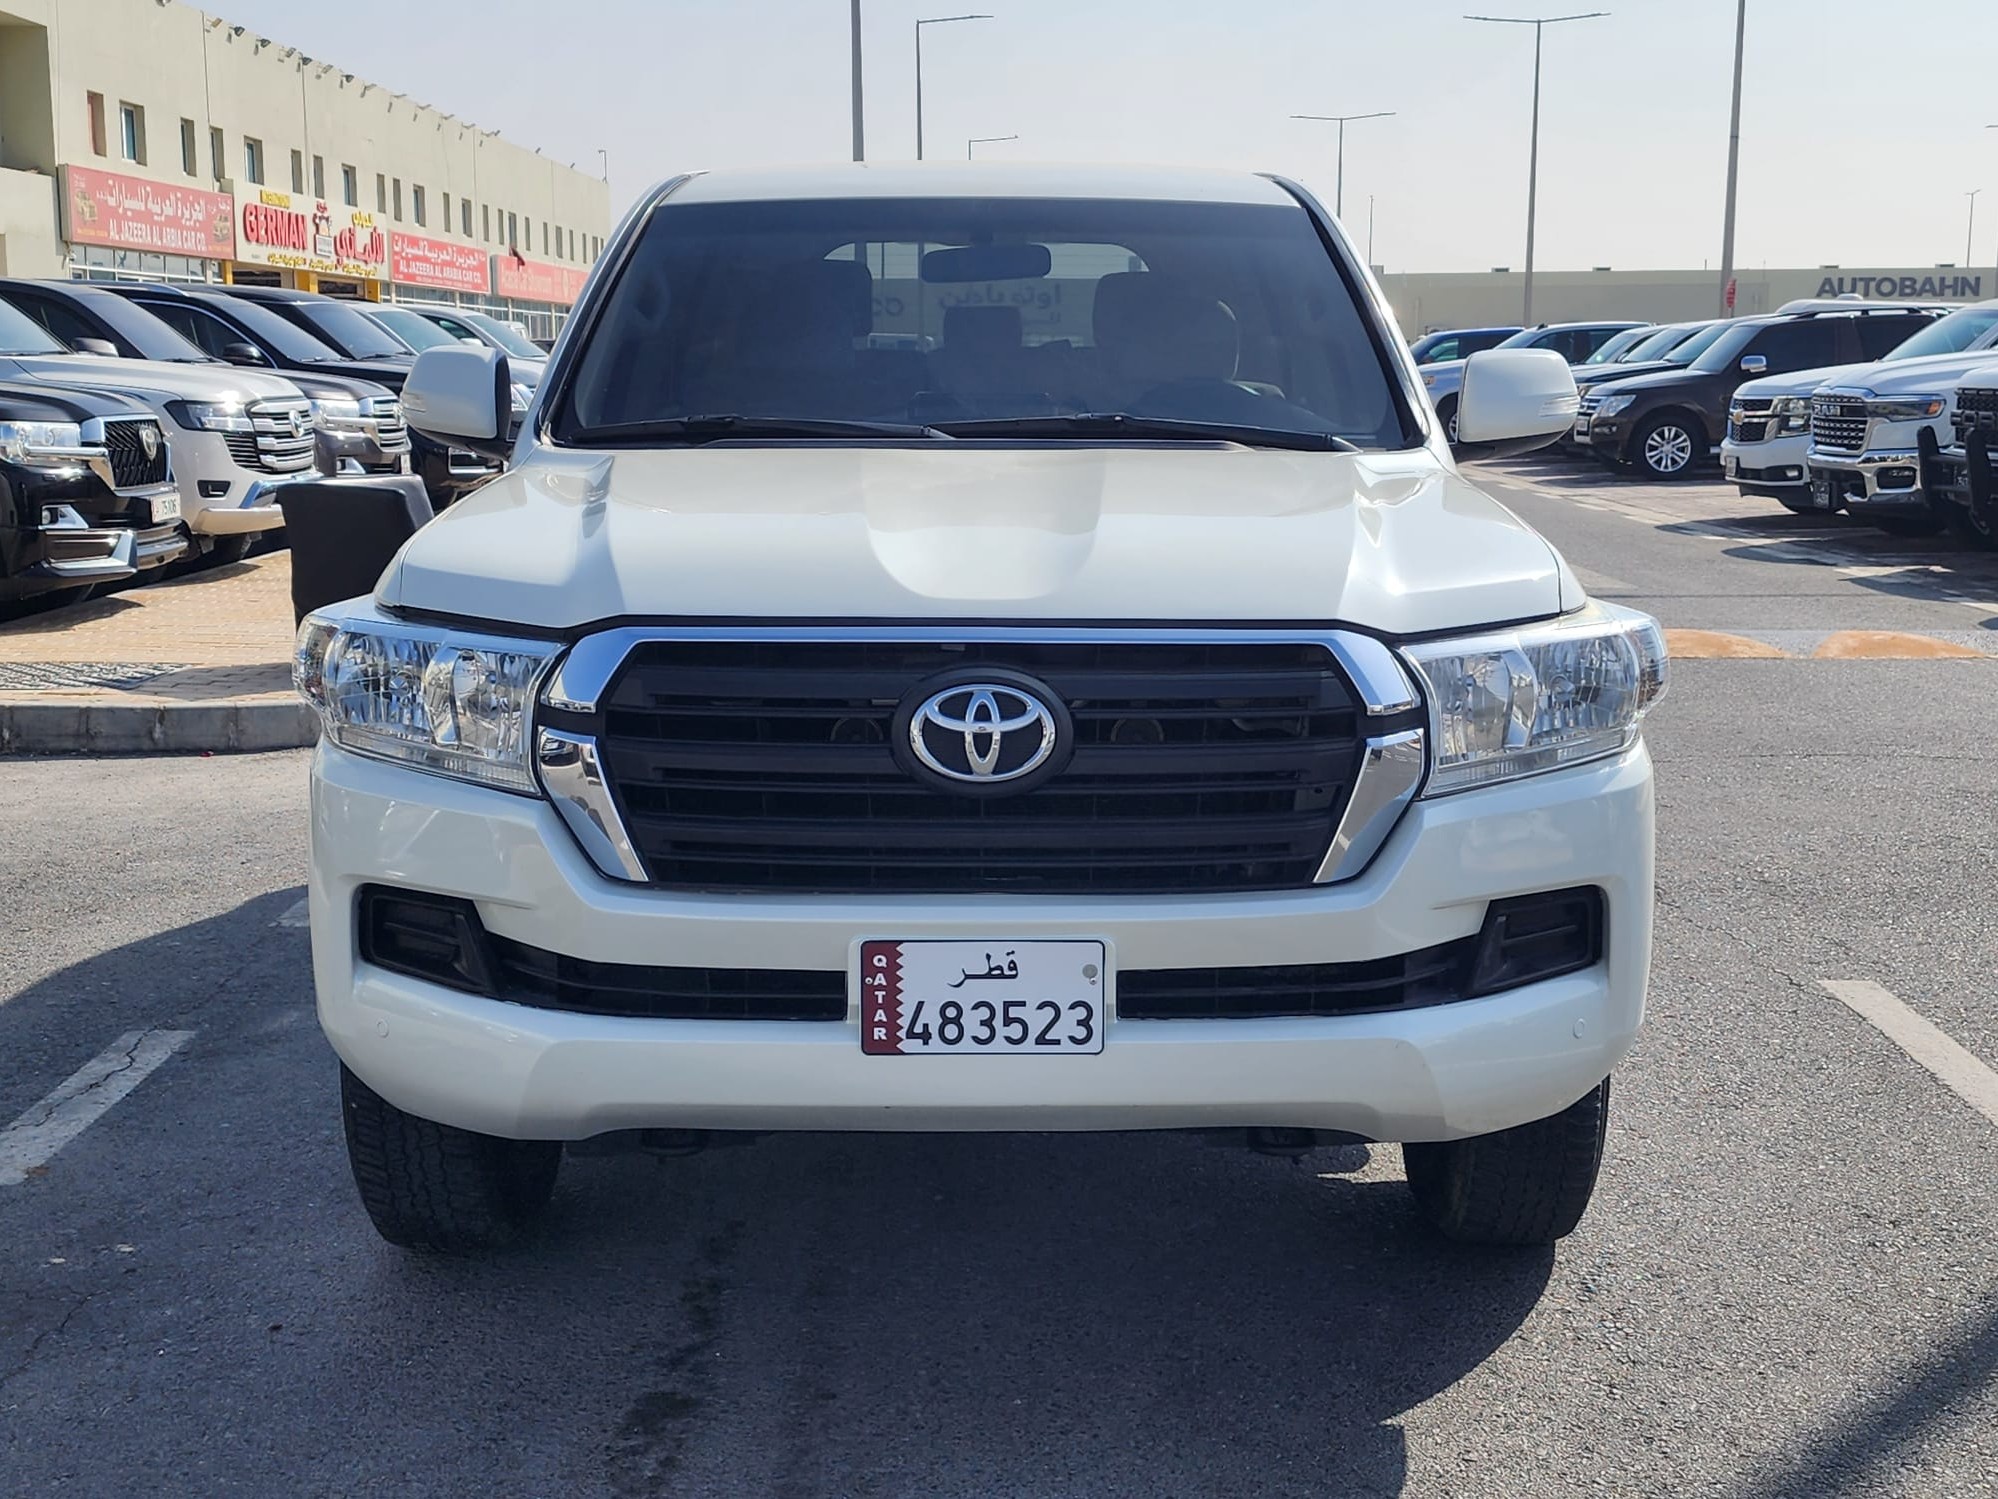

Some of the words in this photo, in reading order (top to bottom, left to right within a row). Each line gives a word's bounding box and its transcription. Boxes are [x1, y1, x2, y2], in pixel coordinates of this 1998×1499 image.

[108, 179, 145, 216] للسيارات
[146, 186, 176, 221] العربية
[177, 191, 206, 227] الجزيرة
[109, 218, 120, 241] AL
[121, 220, 152, 245] JAZEERA
[153, 225, 162, 247] AL
[183, 229, 196, 250] CAR
[243, 203, 307, 250] GERMAN
[393, 234, 424, 258] للسيارات
[424, 240, 453, 263] العربية
[399, 259, 408, 273] AL
[409, 260, 434, 277] JAZEERA
[434, 265, 442, 278] AL
[462, 269, 473, 282] CAR
[1815, 276, 1981, 298] AUTOBAHN
[1814, 404, 1841, 416] RAM
[947, 950, 1019, 988] قطر
[872, 954, 888, 1041] QATAR
[905, 1000, 1094, 1046] 483523
